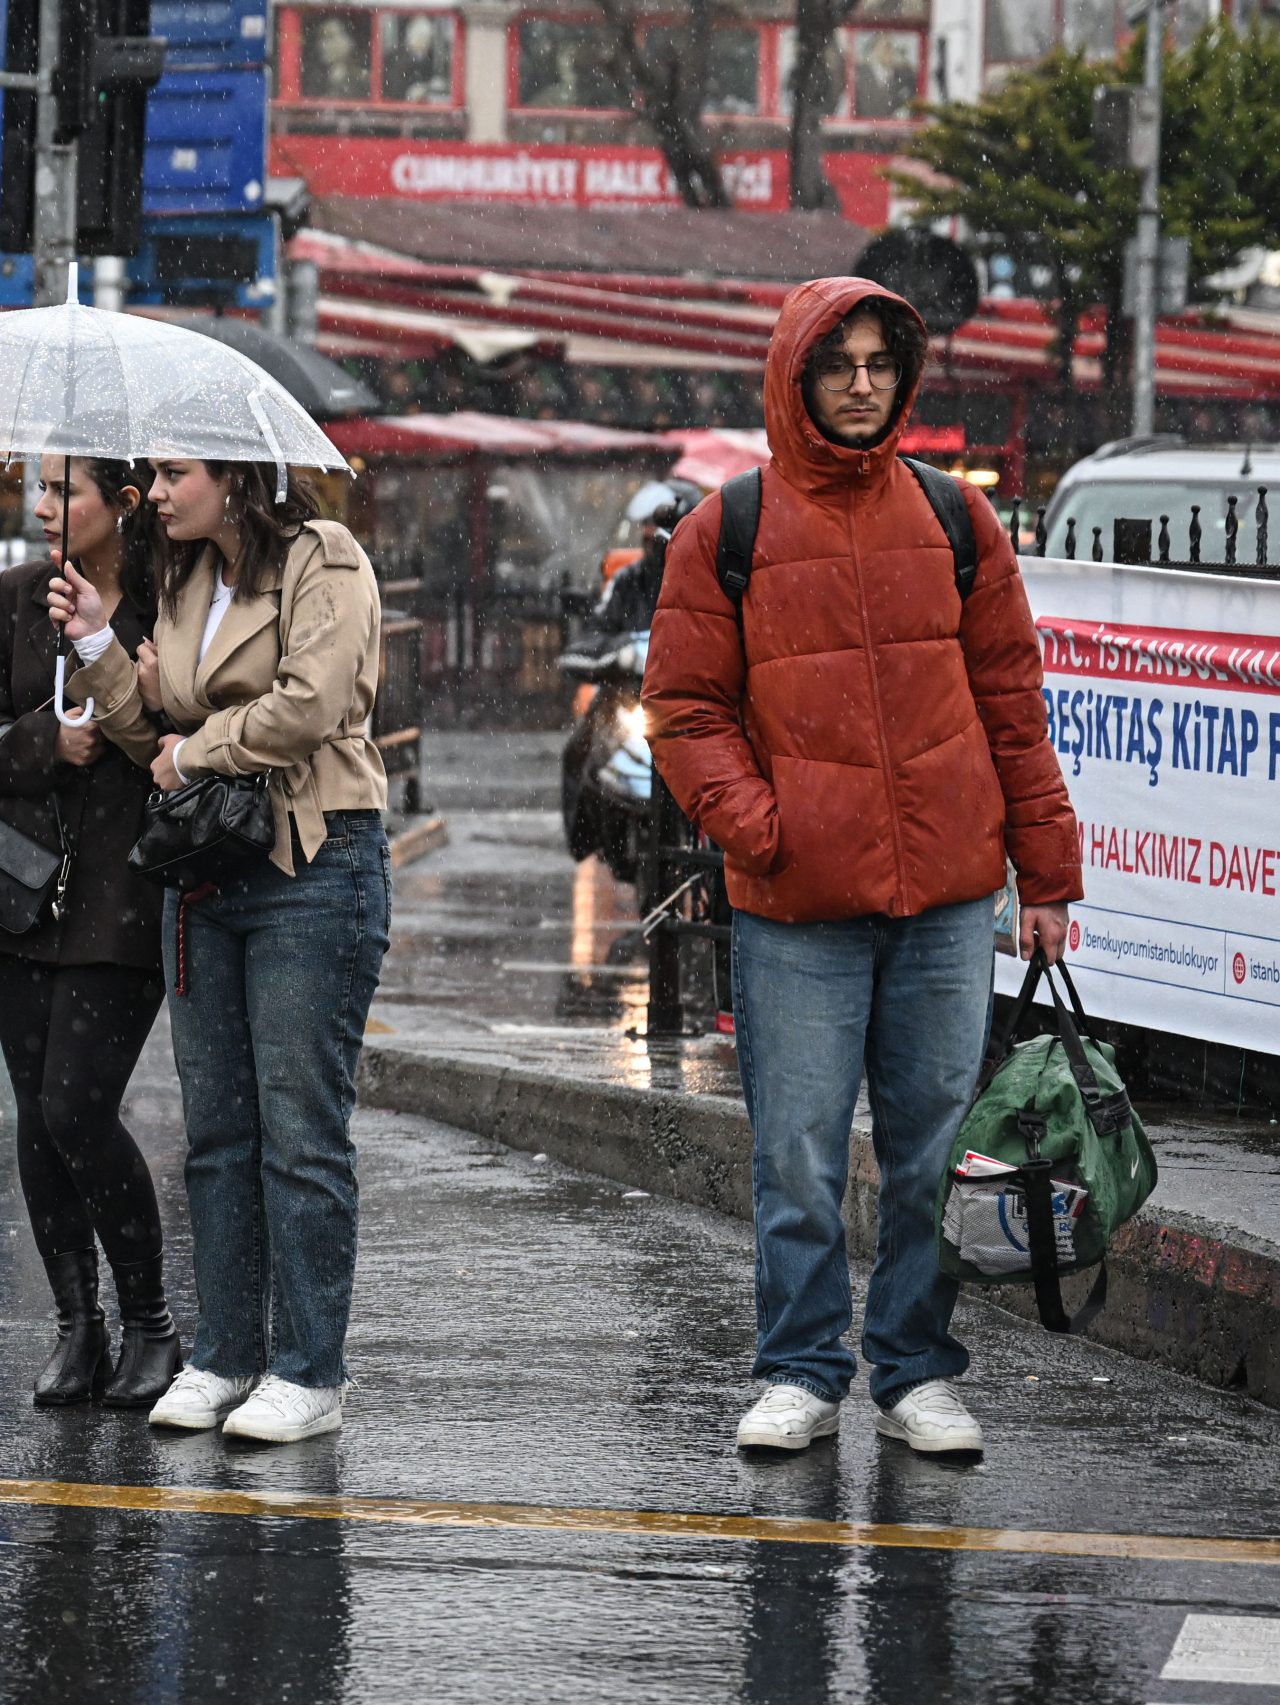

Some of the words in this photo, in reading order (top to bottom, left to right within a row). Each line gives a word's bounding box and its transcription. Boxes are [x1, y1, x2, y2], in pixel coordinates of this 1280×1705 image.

[584, 158, 663, 197] HALK
[1092, 624, 1228, 681] İSTANBUL
[1091, 823, 1201, 884] HALKIMIZ
